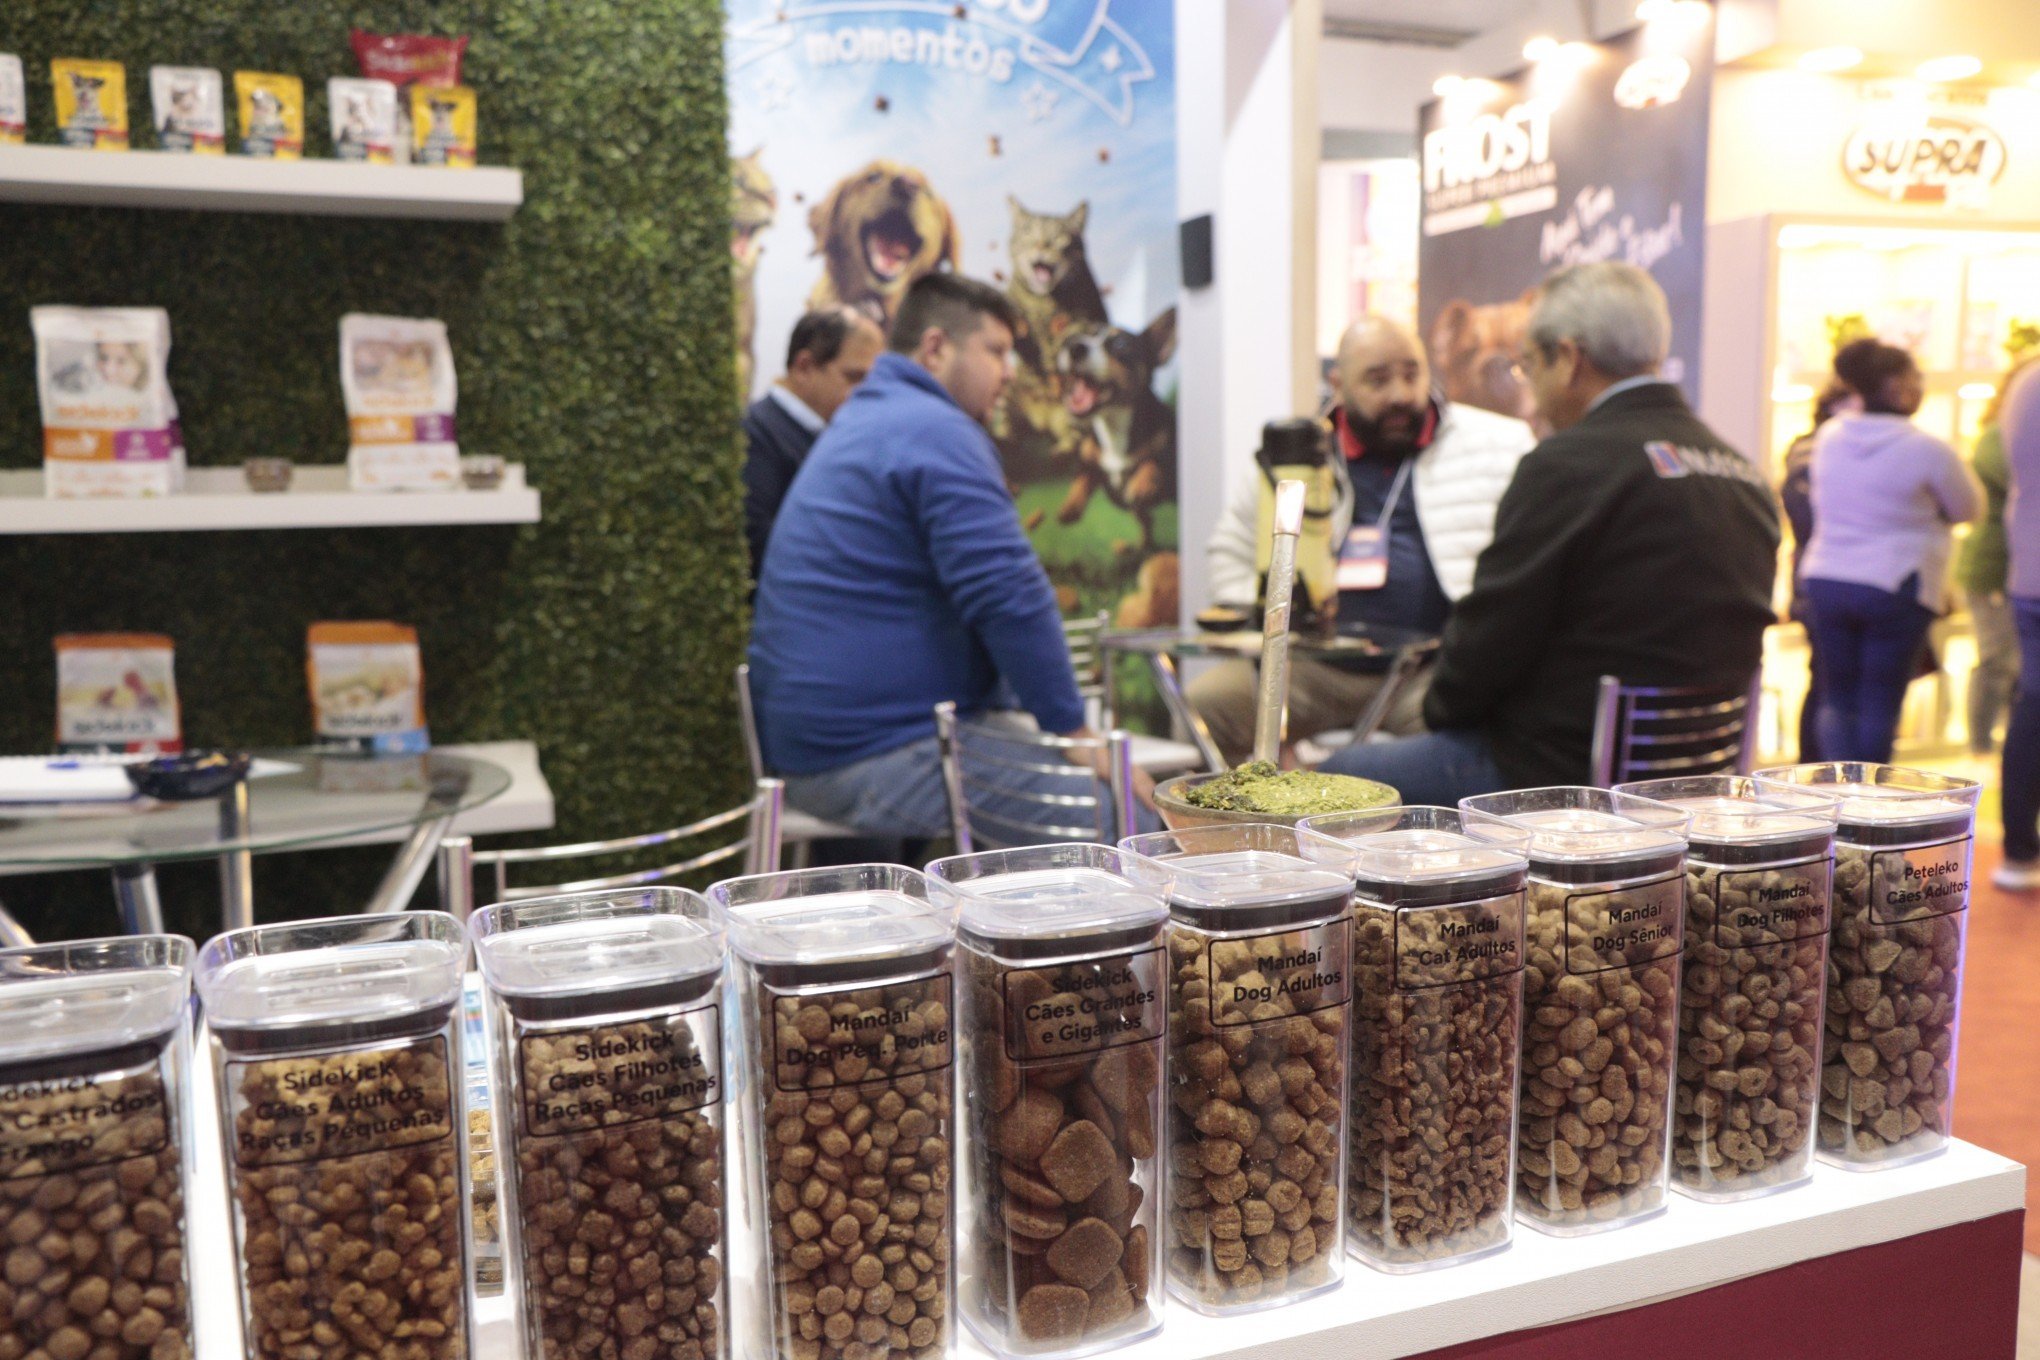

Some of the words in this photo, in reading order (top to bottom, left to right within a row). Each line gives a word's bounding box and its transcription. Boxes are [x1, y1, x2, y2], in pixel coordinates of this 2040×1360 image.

[804, 25, 1016, 82] momentos
[1424, 100, 1555, 193] FROST
[1859, 138, 1987, 175] SUPRA
[1904, 860, 1959, 881] Peteleko
[1758, 882, 1811, 903] Mandaí
[1886, 887, 1922, 905] Cães
[1924, 880, 1969, 900] Adultos
[1440, 914, 1500, 939] Mandaí
[1608, 900, 1663, 925] Mandaí
[1737, 913, 1769, 929] Dog
[1772, 904, 1824, 923] Filhotes
[1593, 936, 1626, 952] Dog
[1629, 923, 1674, 945] Sênior
[1257, 946, 1322, 973] Mandaí
[1419, 948, 1451, 966] Cat
[1455, 939, 1516, 962] Adultos
[1052, 967, 1133, 994] Sidekick
[1233, 985, 1272, 1003] Dog
[1277, 971, 1342, 996] Adultos
[830, 1005, 910, 1033] Mandaí
[1025, 1002, 1076, 1021] Cães
[1080, 988, 1155, 1015] Grandes
[1041, 1030, 1054, 1044] e
[1059, 1015, 1142, 1042] Gigantes
[575, 1029, 676, 1062] Sidekick
[786, 1048, 832, 1067] Dog
[840, 1043, 888, 1061] Peq.
[894, 1029, 948, 1051] Porte
[283, 1059, 397, 1090] Sidekick
[613, 1053, 702, 1083] Filhotes
[0, 1077, 100, 1102] dekick
[327, 1084, 425, 1114] Adultos
[535, 1100, 605, 1122] Raças
[612, 1073, 717, 1108] Pequenas
[16, 1094, 158, 1130] Castrados
[239, 1130, 316, 1153] Raças
[321, 1108, 444, 1141] Pequenas
